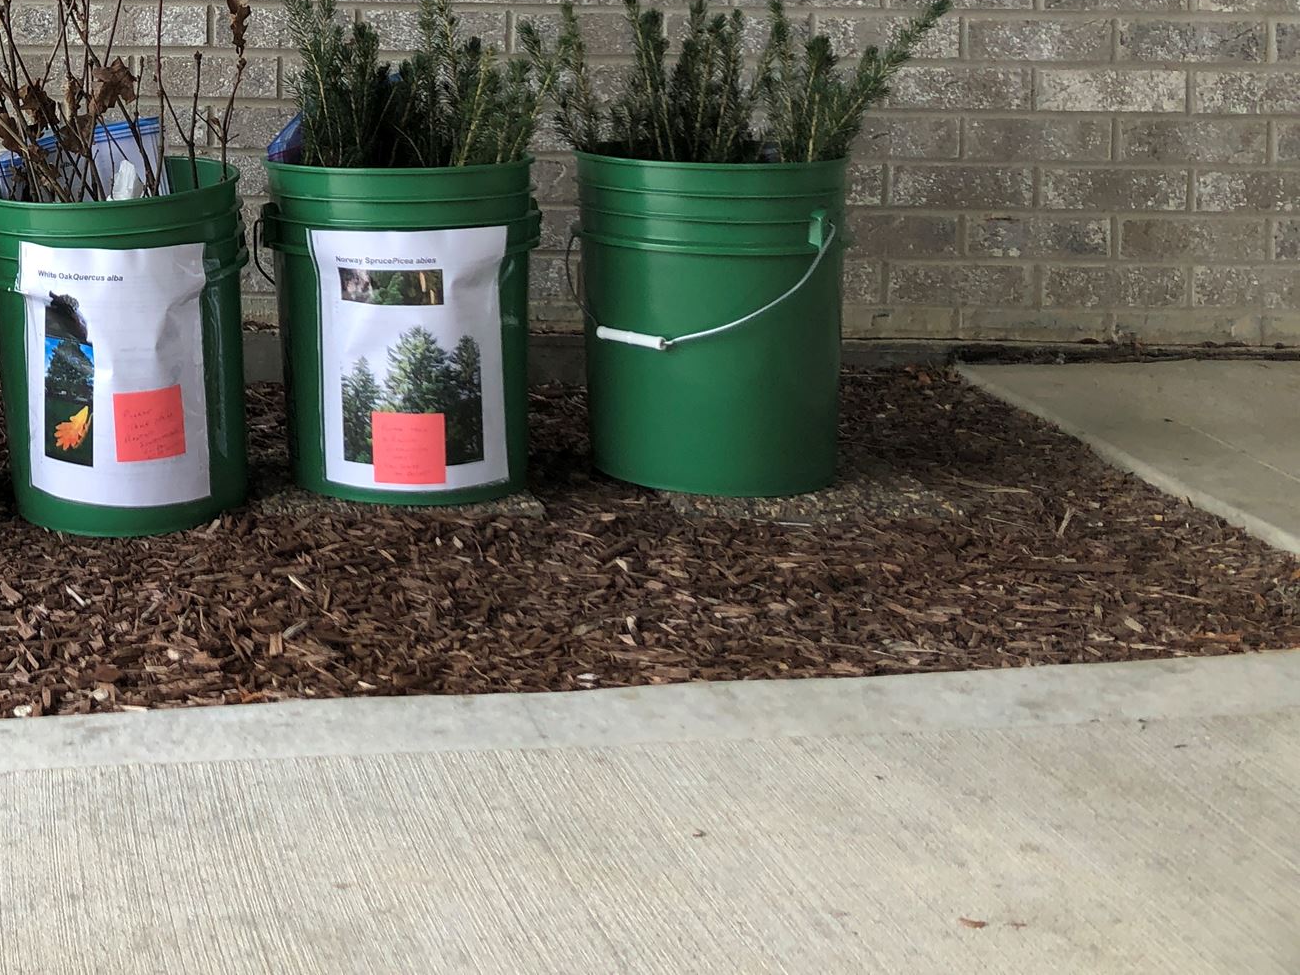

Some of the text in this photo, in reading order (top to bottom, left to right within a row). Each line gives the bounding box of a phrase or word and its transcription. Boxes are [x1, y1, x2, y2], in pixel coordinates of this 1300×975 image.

[335, 256, 363, 264] Norway
[37, 269, 57, 279] White
[106, 274, 124, 282] alba
